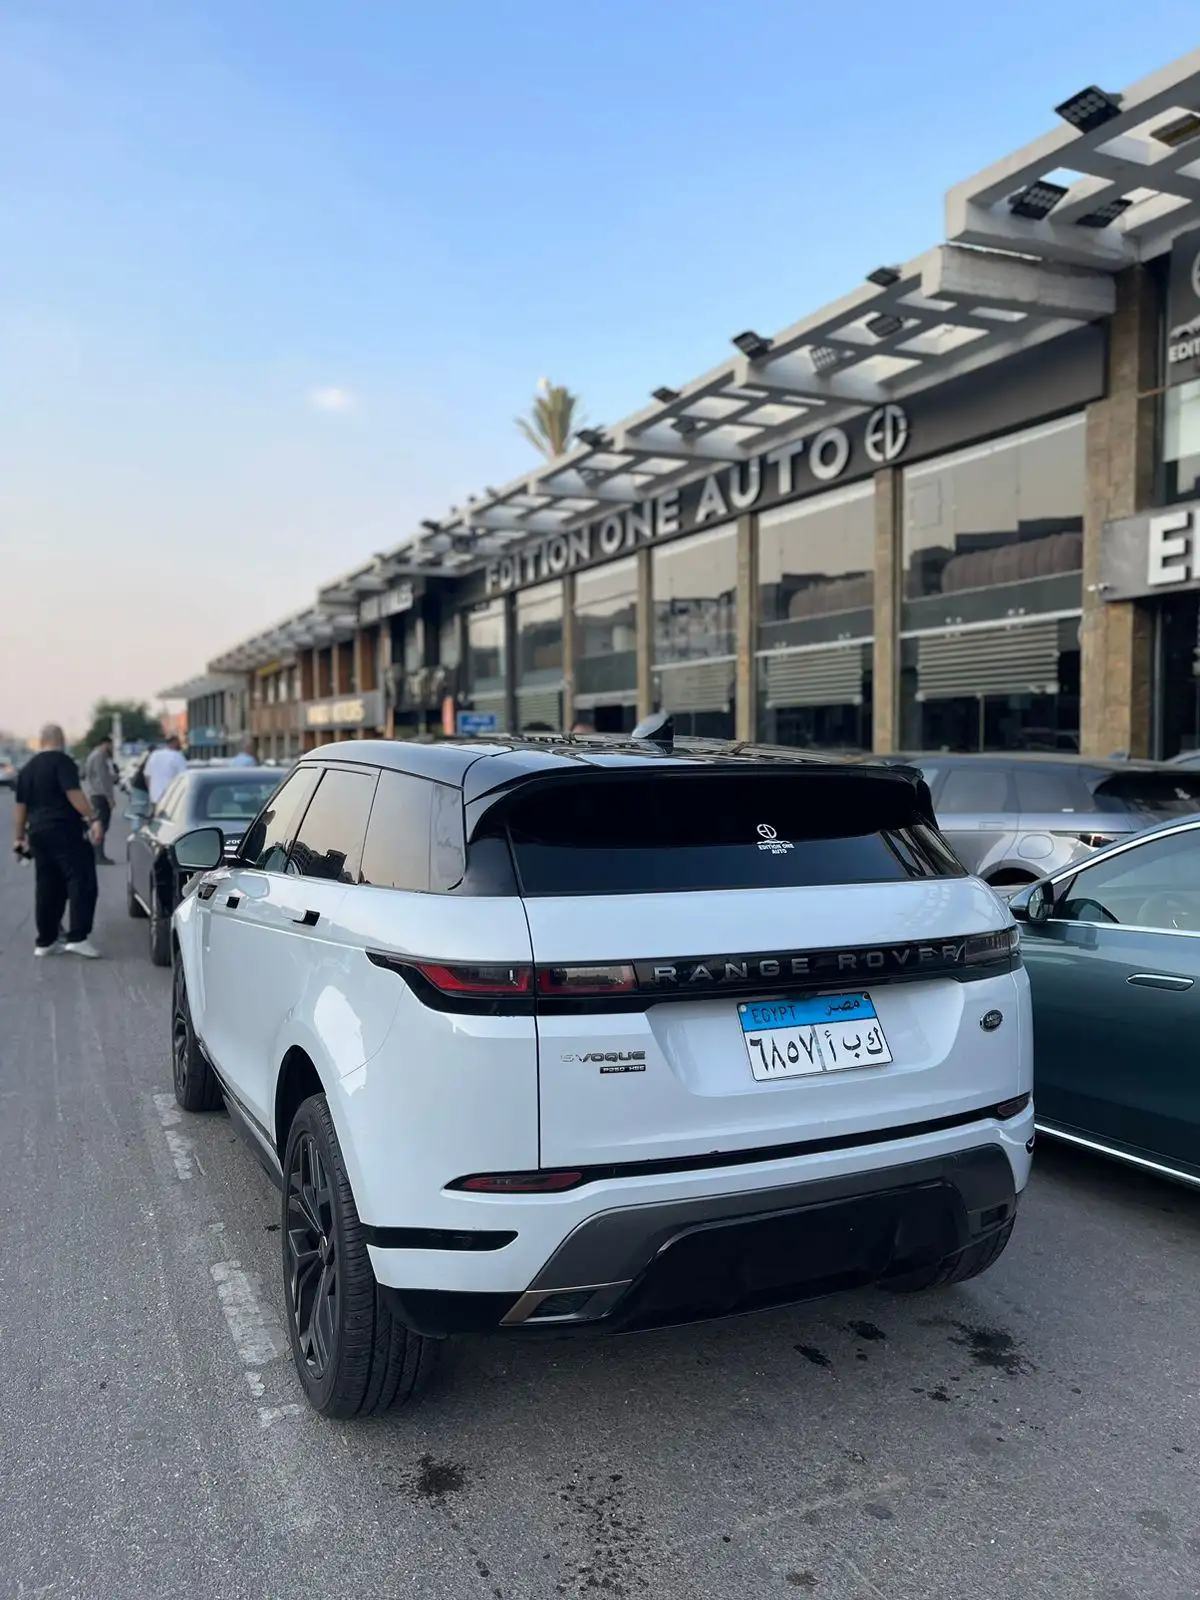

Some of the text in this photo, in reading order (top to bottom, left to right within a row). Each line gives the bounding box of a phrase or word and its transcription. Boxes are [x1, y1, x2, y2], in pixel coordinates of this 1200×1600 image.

[485, 523, 590, 594] EDITION
[600, 489, 680, 553] ONE
[695, 427, 849, 523] AUTO
[1148, 509, 1200, 585] E
[653, 944, 959, 985] RANGE ROVER
[751, 1005, 797, 1024] EGYPT
[825, 1000, 860, 1016] مصر
[560, 1050, 646, 1063] EVOQUE
[750, 1032, 814, 1072] ٦٨٥٧
